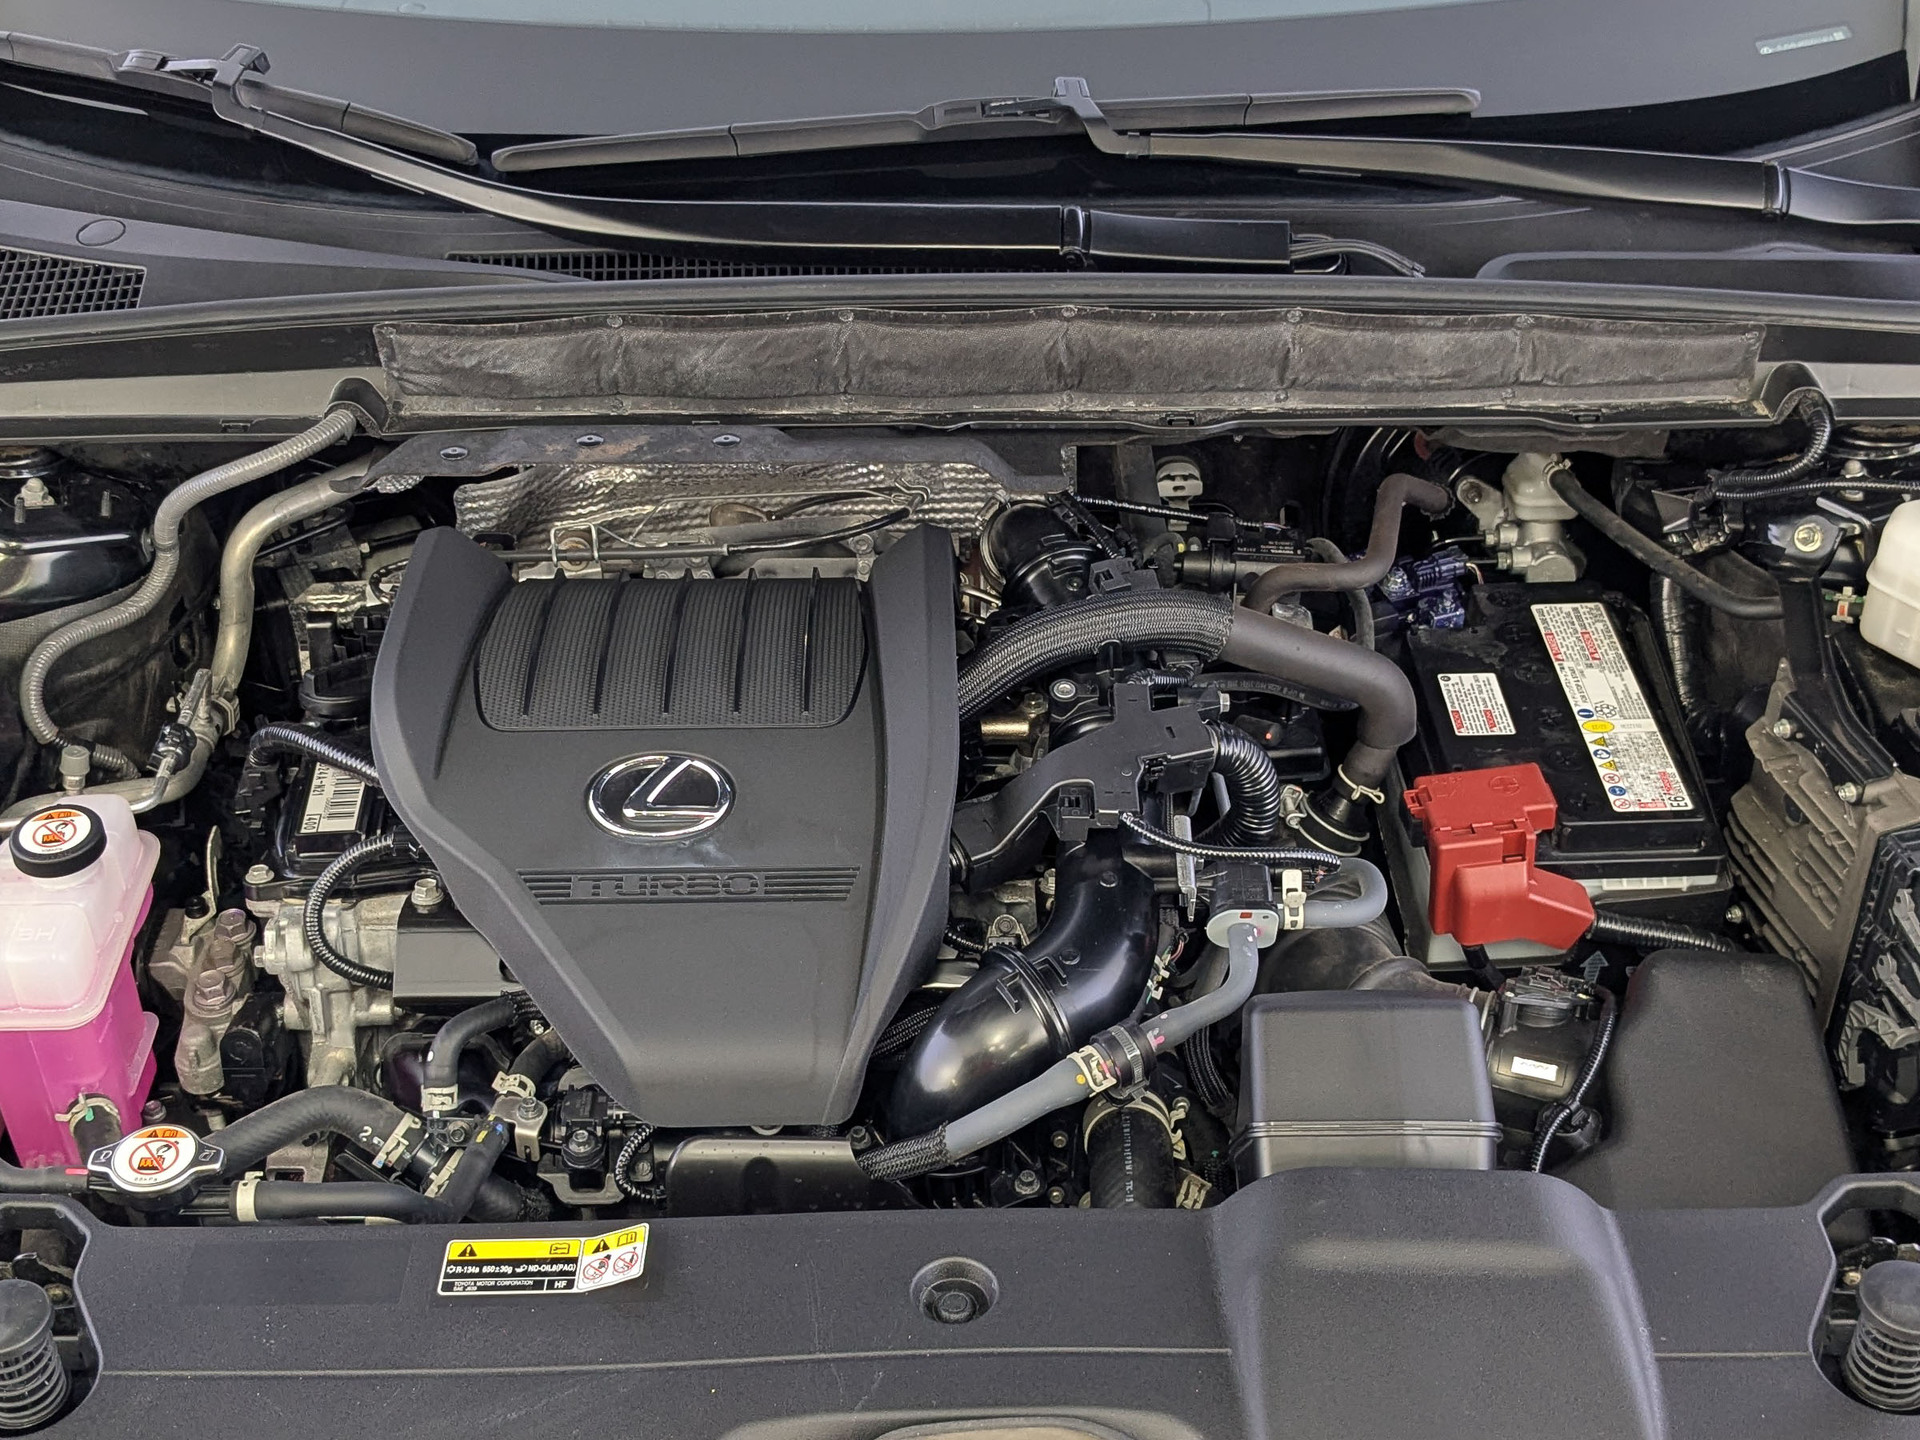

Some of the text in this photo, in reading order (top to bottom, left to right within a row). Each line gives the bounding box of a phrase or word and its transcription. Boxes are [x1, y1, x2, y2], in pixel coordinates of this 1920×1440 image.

[1668, 795, 1688, 808] E6
[578, 872, 760, 897] TURBO
[455, 1265, 480, 1274] R-134a
[554, 1280, 568, 1288] HF
